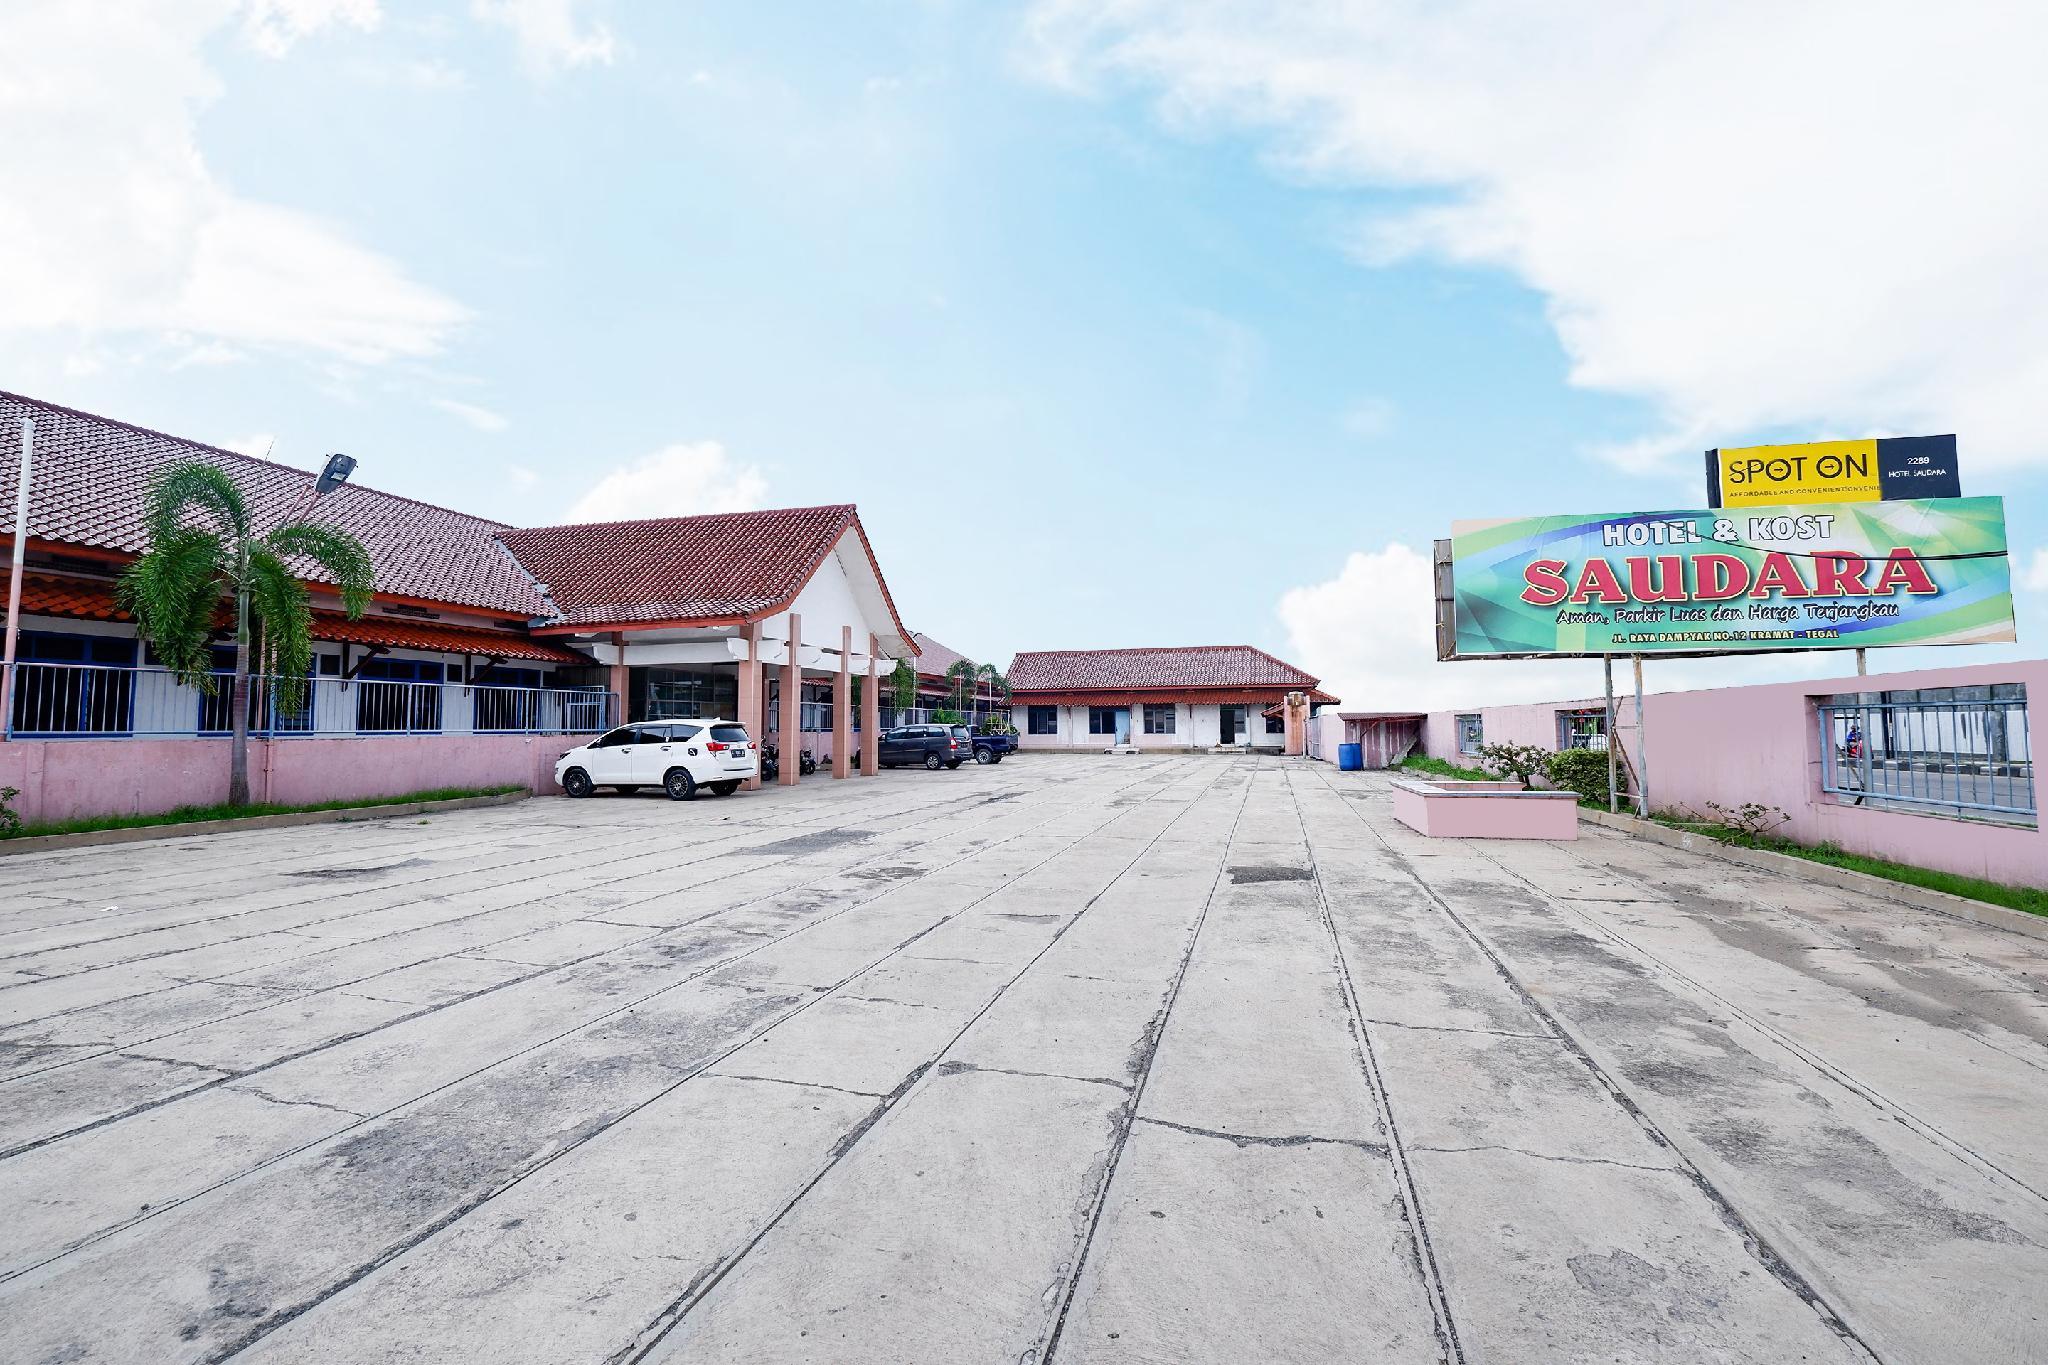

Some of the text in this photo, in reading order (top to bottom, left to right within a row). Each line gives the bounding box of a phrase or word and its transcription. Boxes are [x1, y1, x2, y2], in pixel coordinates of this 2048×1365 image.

[1729, 453, 1868, 484] SPOT ON
[1907, 456, 1930, 465] 2289
[1602, 514, 1835, 547] HOTEL & KOST
[1519, 547, 1938, 606] SAUDARA
[1555, 600, 1900, 626] Aman, Parkir Luas dan Harga Terjangkau
[1612, 633, 1627, 644] JL.
[1629, 632, 1657, 643] RAYA
[1658, 631, 1711, 642] DAMPYAK
[1712, 631, 1747, 641] NO.12
[1750, 630, 1795, 640] KRAMAT
[1805, 629, 1840, 640] TEGAL
